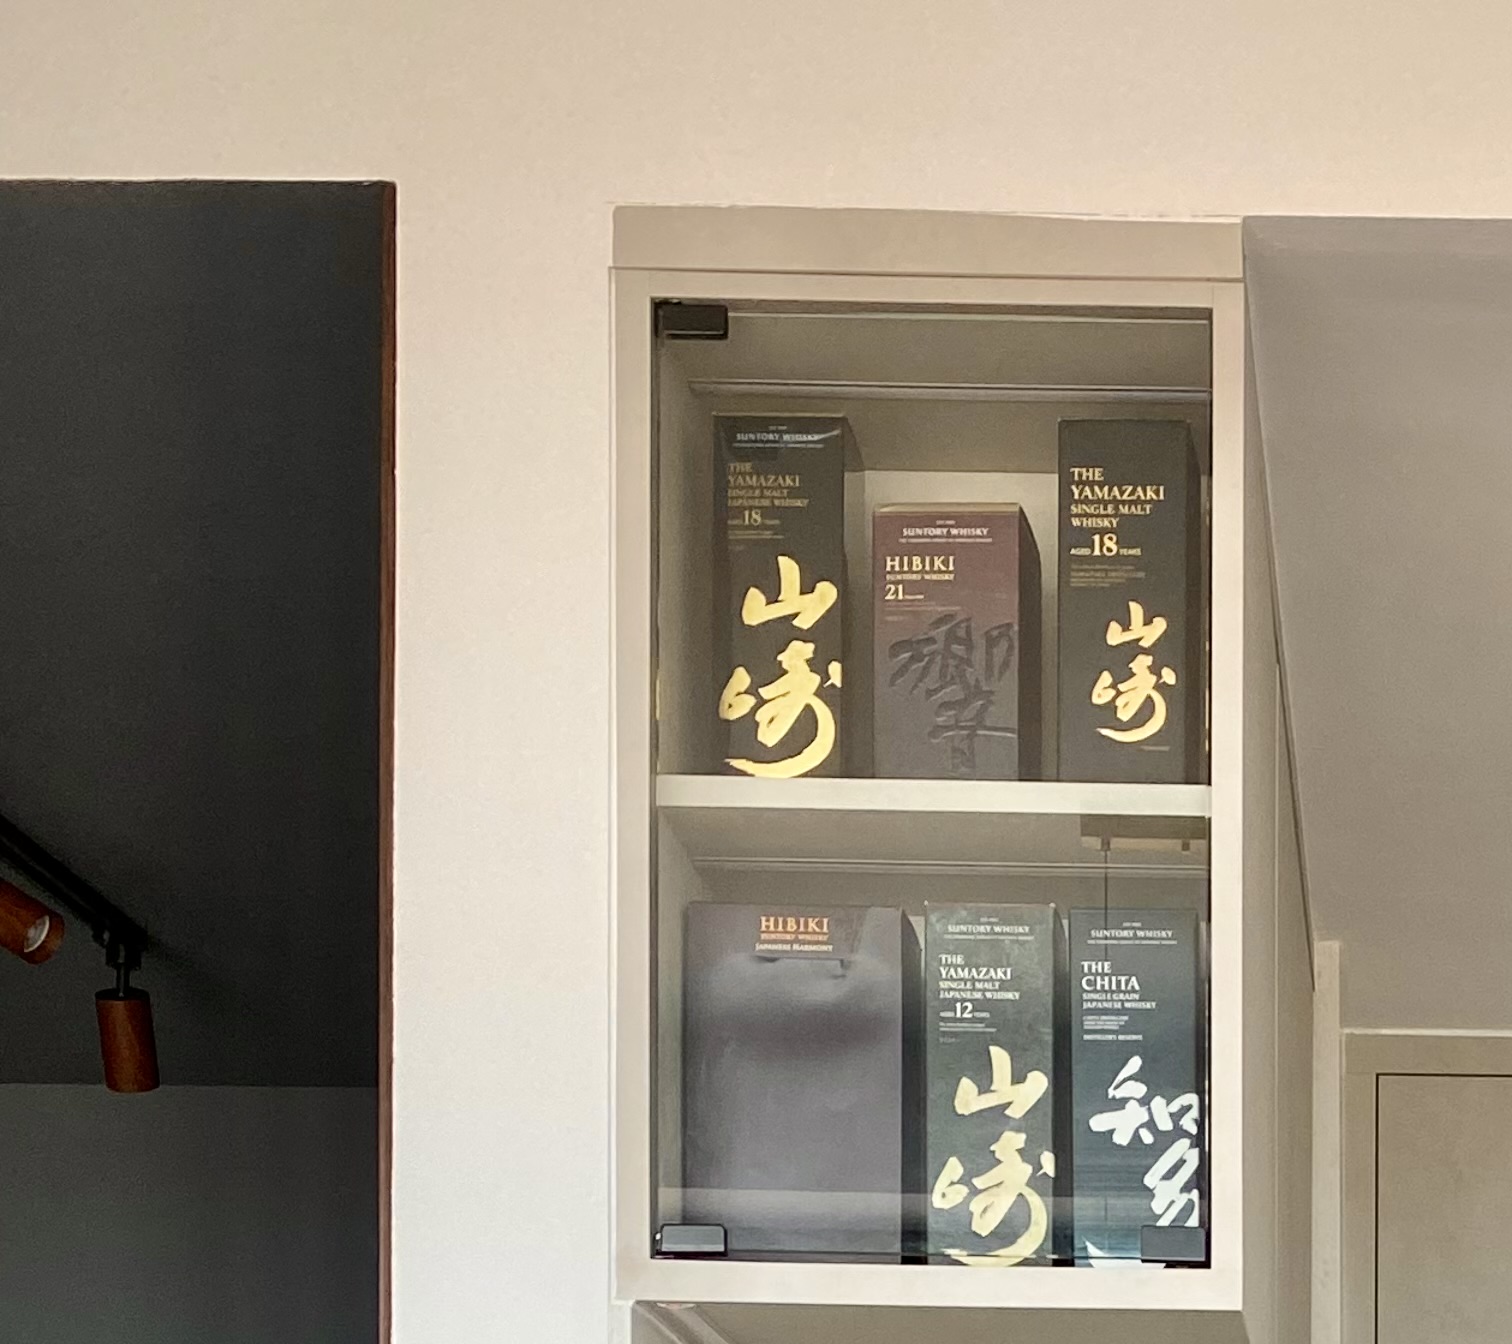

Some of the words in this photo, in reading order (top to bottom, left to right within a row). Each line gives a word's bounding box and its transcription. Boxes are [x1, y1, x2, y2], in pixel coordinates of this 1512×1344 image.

[727, 474, 800, 488] YAMAZAKI
[1070, 467, 1105, 481] THE
[1071, 485, 1165, 500] YAMAZAKI
[1070, 503, 1116, 514] SINGLE
[1118, 503, 1153, 515] MALT
[743, 509, 762, 526] 18
[1071, 517, 1120, 528] WHISKY
[902, 527, 948, 537] SUNTORY
[949, 527, 989, 537] WHISKY
[1091, 533, 1118, 556] 18
[885, 555, 956, 571] HIBIKI
[884, 584, 904, 600] 21
[760, 916, 830, 933] HIBIKI
[1091, 929, 1135, 938] SUNTORY
[1136, 929, 1173, 938] WHISKY
[938, 953, 965, 965] THE
[939, 967, 1012, 980] YAMAZAKI
[1081, 961, 1112, 974] THE
[1081, 975, 1141, 991] CHITA
[955, 1001, 974, 1018] 12
